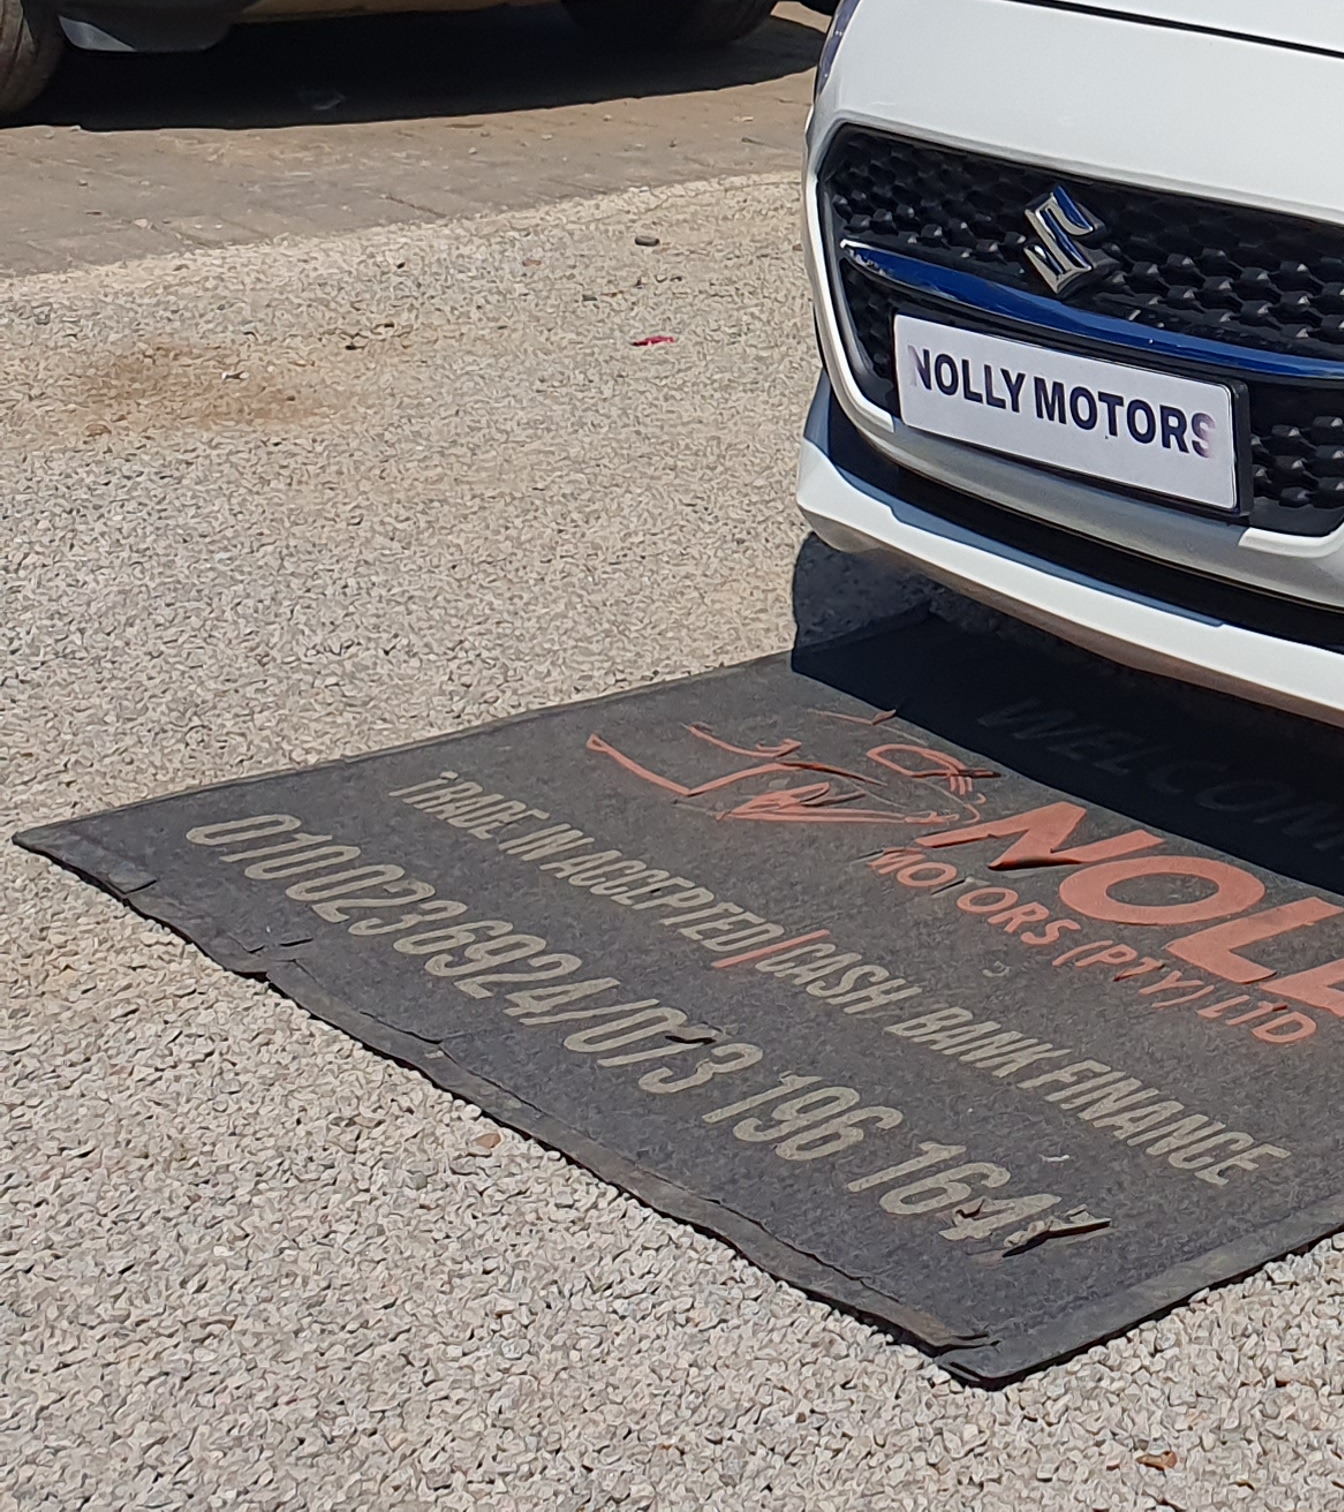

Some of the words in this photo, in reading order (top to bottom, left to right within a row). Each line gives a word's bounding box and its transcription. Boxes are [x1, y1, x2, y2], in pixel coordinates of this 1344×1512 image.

[907, 344, 1026, 414] NOLLY
[1033, 377, 1218, 460] MOTORS
[388, 770, 551, 840] TRADE
[498, 823, 595, 861] IN
[883, 1006, 1072, 1078] BANK
[1017, 1059, 1292, 1186] FINANCE
[1052, 939, 1215, 1009] (PTY)
[1197, 994, 1318, 1044] LTD
[702, 1070, 904, 1161] 196
